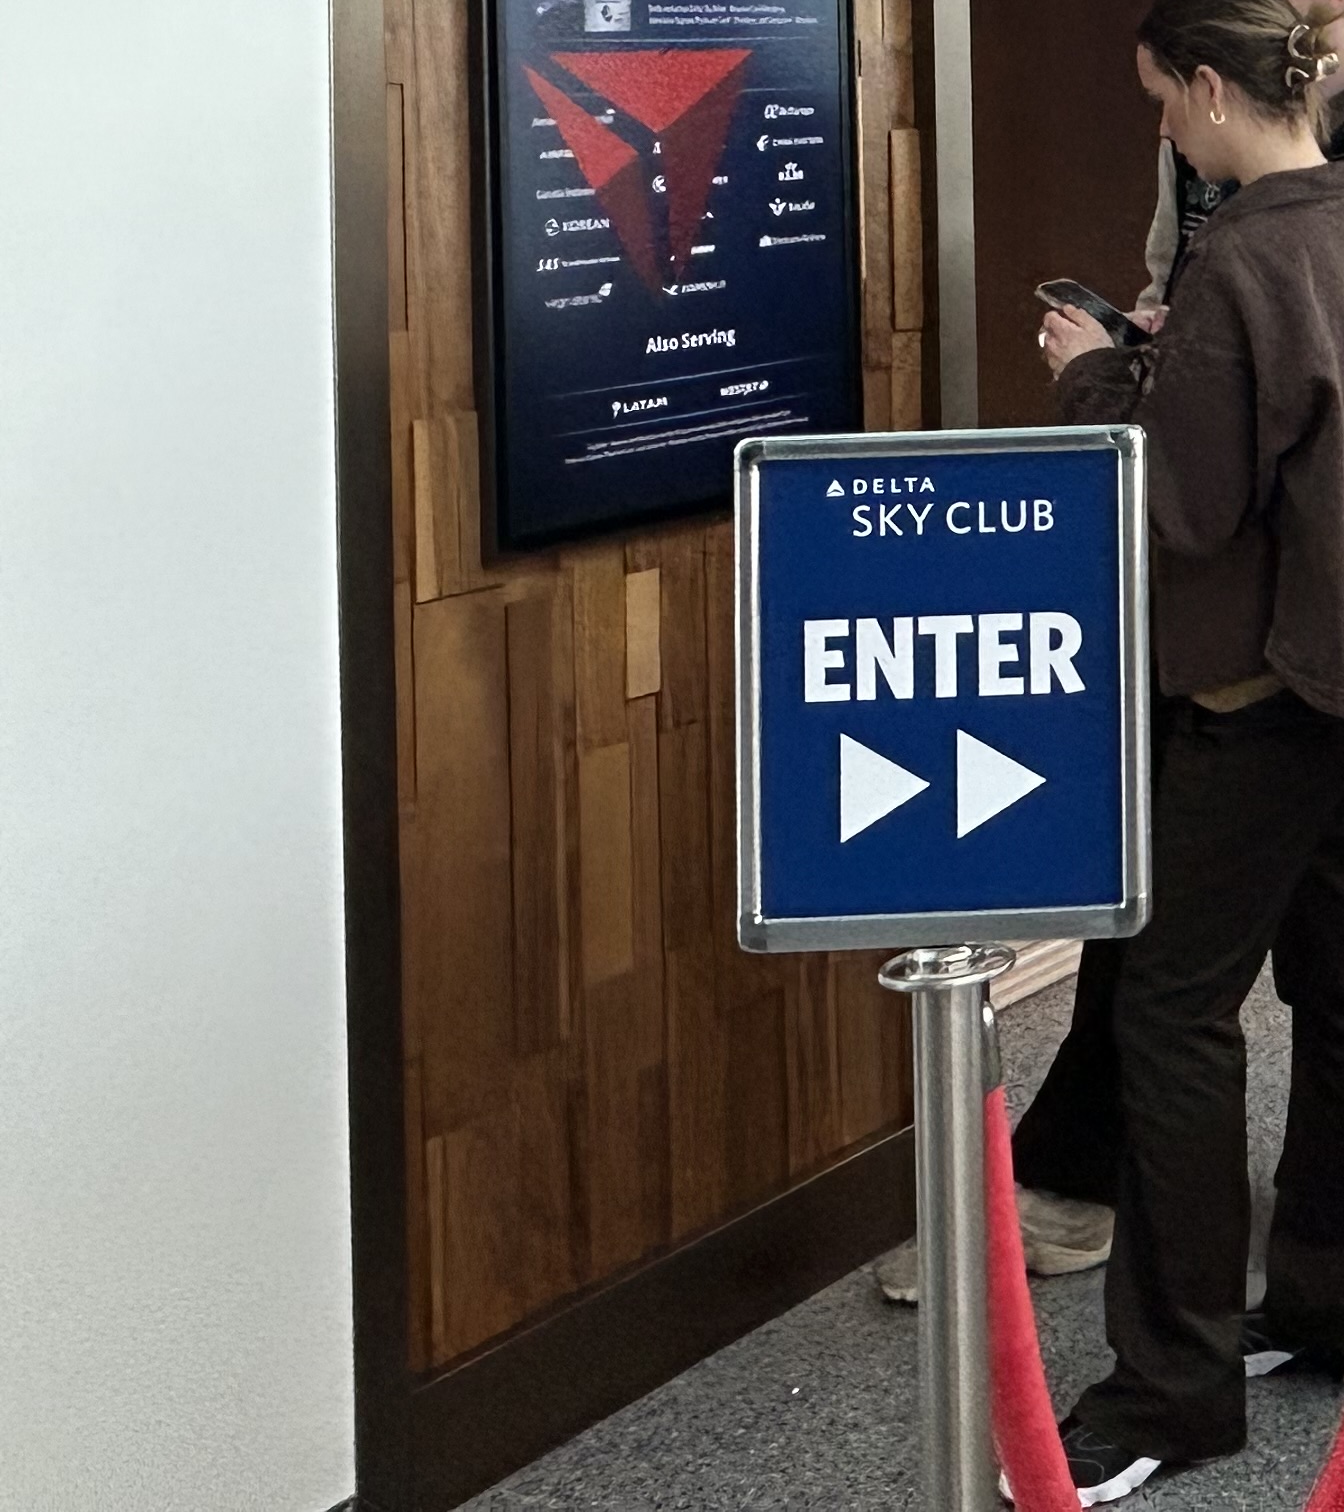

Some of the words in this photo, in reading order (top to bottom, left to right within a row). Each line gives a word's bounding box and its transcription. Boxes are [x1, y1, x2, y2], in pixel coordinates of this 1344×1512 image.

[645, 336, 679, 354] Also
[681, 328, 737, 348] Serving
[853, 476, 936, 496] DELTA
[852, 502, 935, 538] SKY
[946, 499, 1056, 535] CLUB
[803, 611, 1086, 704] ENTER
